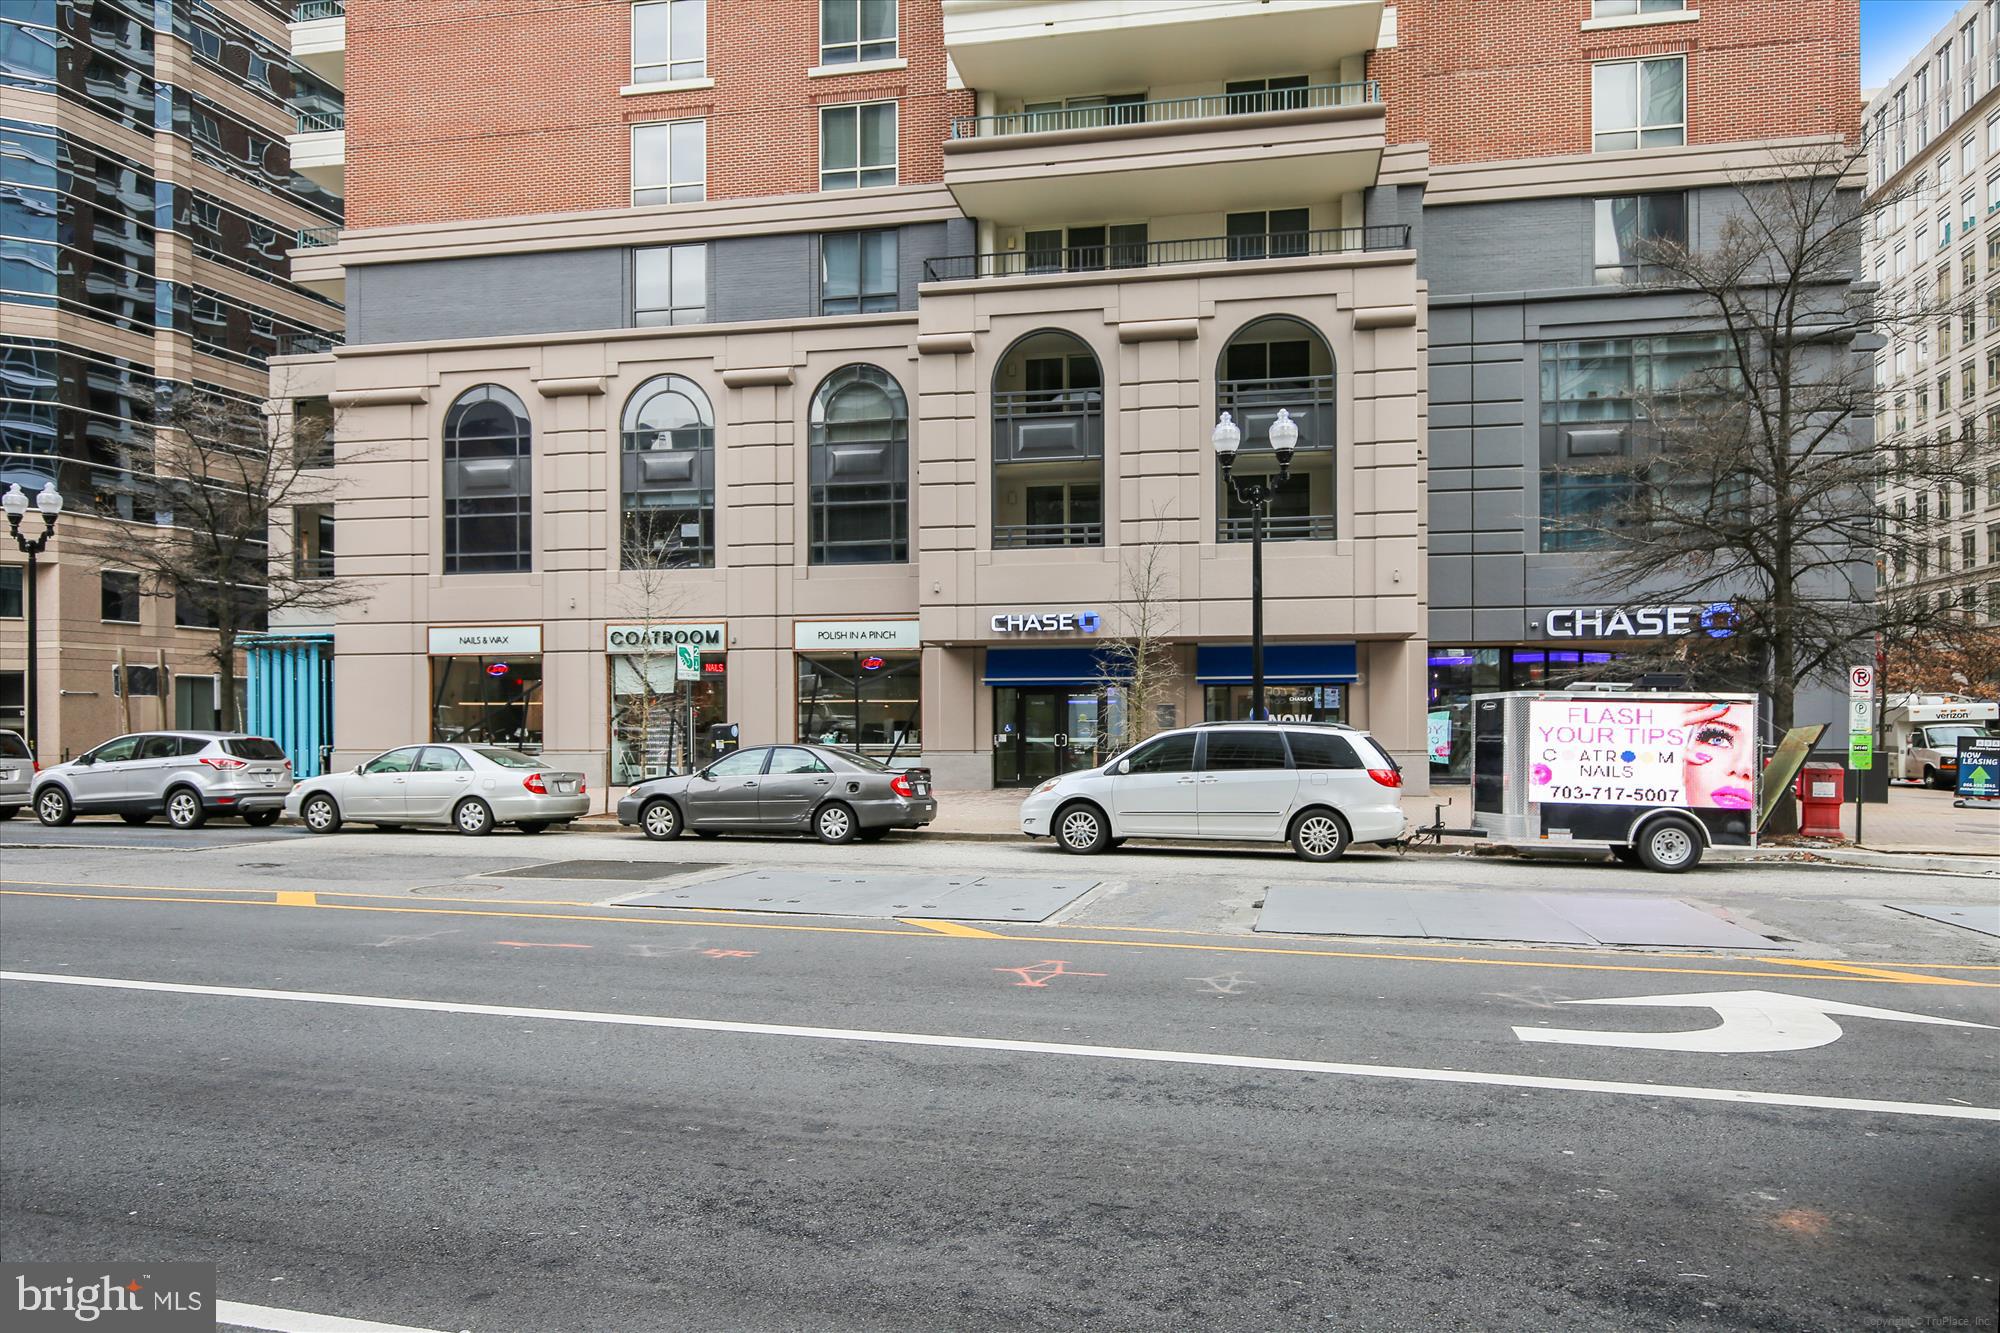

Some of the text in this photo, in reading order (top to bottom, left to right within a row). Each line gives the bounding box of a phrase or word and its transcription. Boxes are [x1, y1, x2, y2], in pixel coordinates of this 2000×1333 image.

[991, 613, 1075, 632] CHASE
[1546, 607, 1693, 637] CHASE
[459, 636, 509, 645] NAILS & WAX
[610, 630, 720, 646] COATROOM
[818, 630, 897, 640] POLISH IN A PINCH
[705, 663, 724, 673] NAILS
[1568, 707, 1653, 725] FLASH
[1936, 712, 1969, 720] verizon
[1539, 726, 1684, 746] YOUR TIPS
[1961, 751, 1981, 759] NOW
[1962, 758, 1998, 766] LEASING
[1580, 764, 1634, 779] NAILS
[1550, 785, 1680, 803] 703-717-5007
